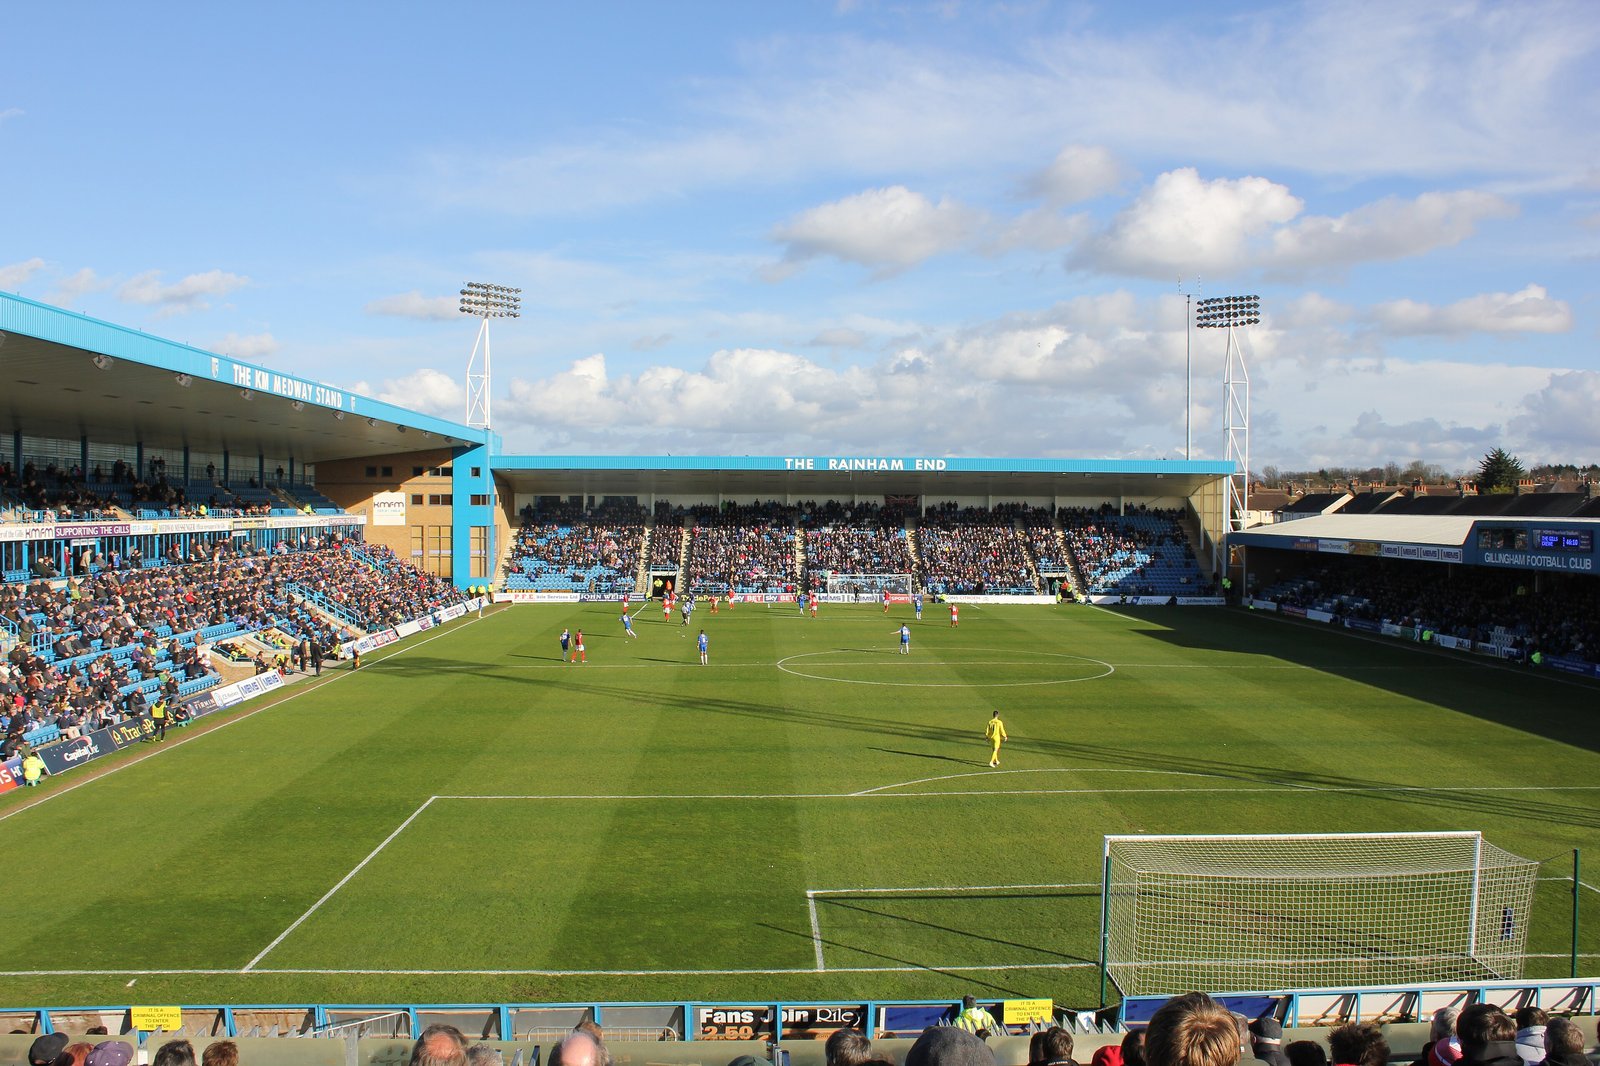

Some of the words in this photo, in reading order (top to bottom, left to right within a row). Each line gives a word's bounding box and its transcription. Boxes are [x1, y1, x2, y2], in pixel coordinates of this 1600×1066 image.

[232, 363, 251, 387] THE
[255, 369, 269, 391] KM
[273, 375, 313, 400] MEDWAY
[316, 386, 342, 408] STAND
[784, 458, 814, 470] THE
[829, 458, 904, 470] RAINHAM
[915, 459, 946, 470] END
[56, 526, 98, 537] SUPPORTING
[100, 525, 113, 535] THE
[113, 525, 130, 534] GILLS
[1484, 552, 1526, 566] GILLINGHAM
[1526, 555, 1567, 568] FOOTBALL
[1569, 557, 1592, 570] CLUB
[701, 1008, 754, 1024] Fans
[816, 1008, 865, 1027] Riley
